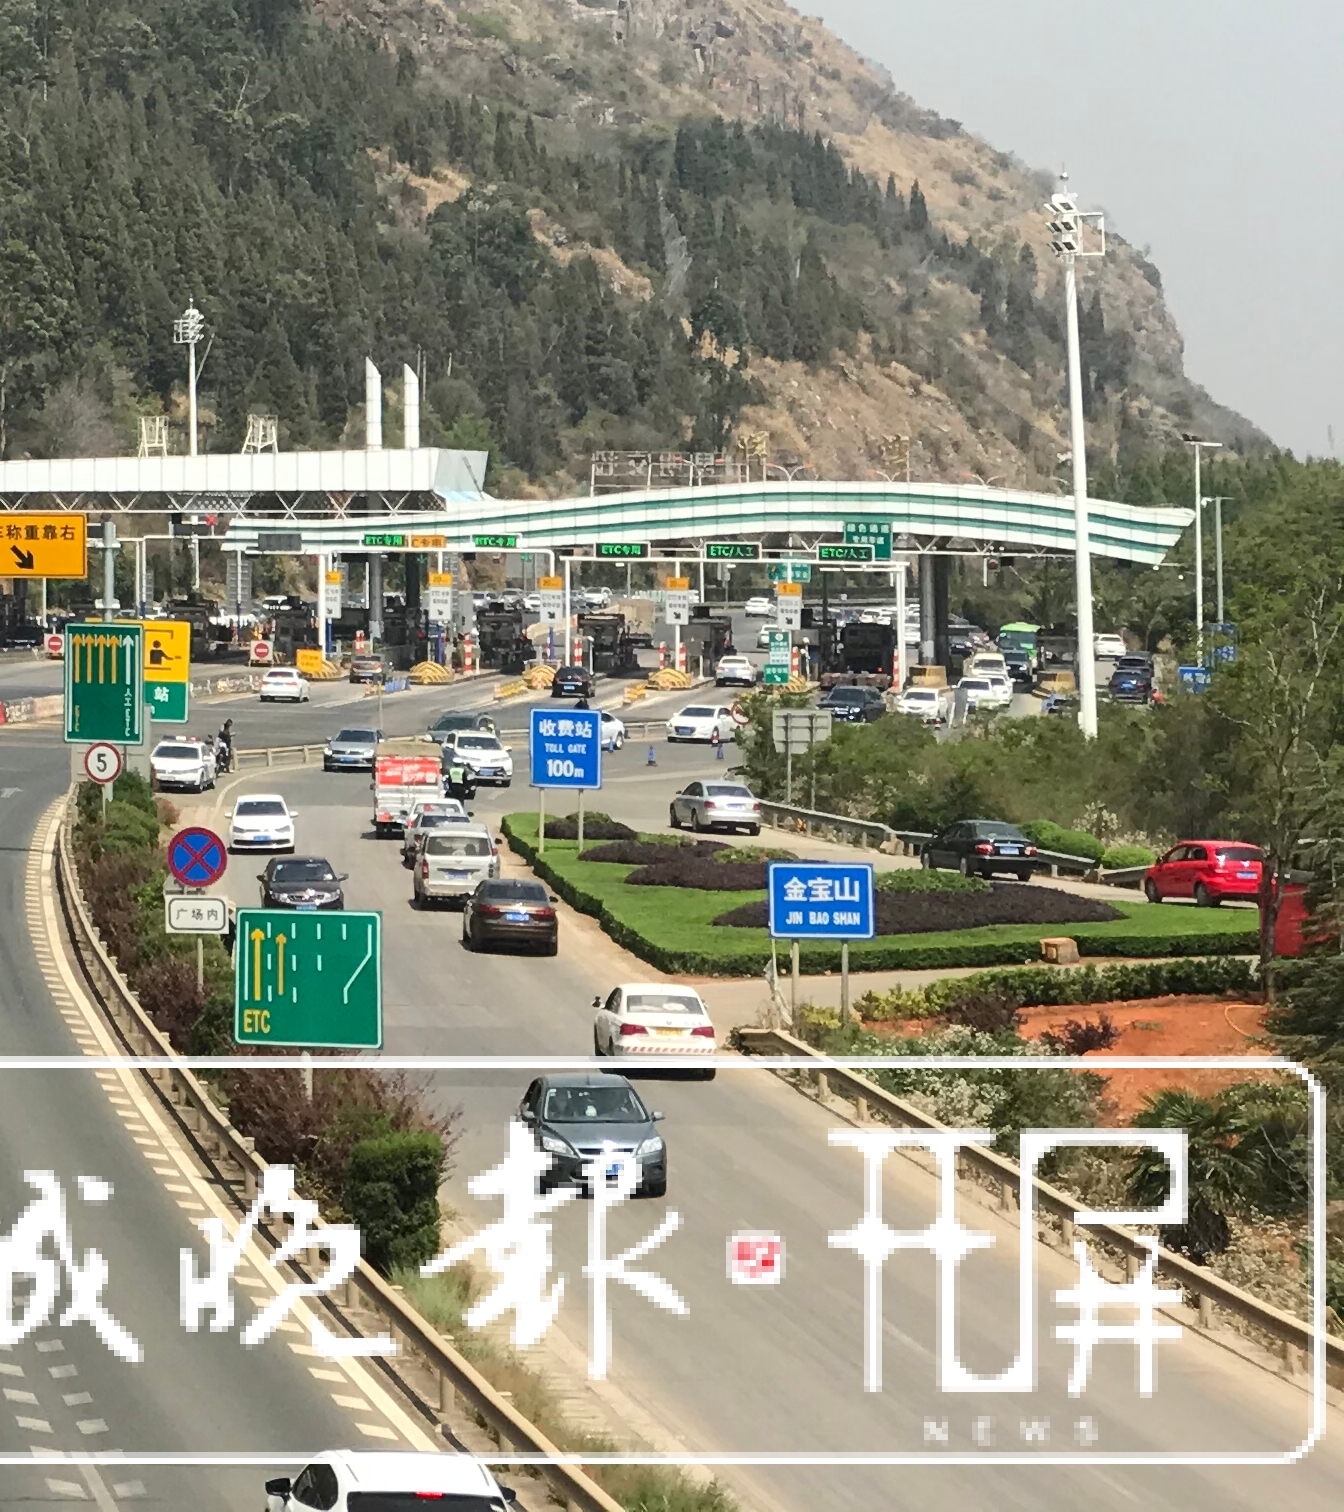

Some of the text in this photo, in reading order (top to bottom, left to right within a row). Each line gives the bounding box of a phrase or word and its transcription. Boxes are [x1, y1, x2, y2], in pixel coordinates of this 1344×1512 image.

[709, 545, 754, 558] ETC/人工
[820, 547, 869, 559] ETC/人工
[538, 718, 593, 739] 收费站
[544, 742, 587, 755] TOLL GATE
[96, 753, 108, 773] 5
[546, 758, 585, 778] 100m
[783, 876, 860, 903] 金宝山
[175, 907, 220, 922] 广场内
[785, 911, 861, 926] JIN BAO SHAN
[243, 1009, 271, 1034] ETC
